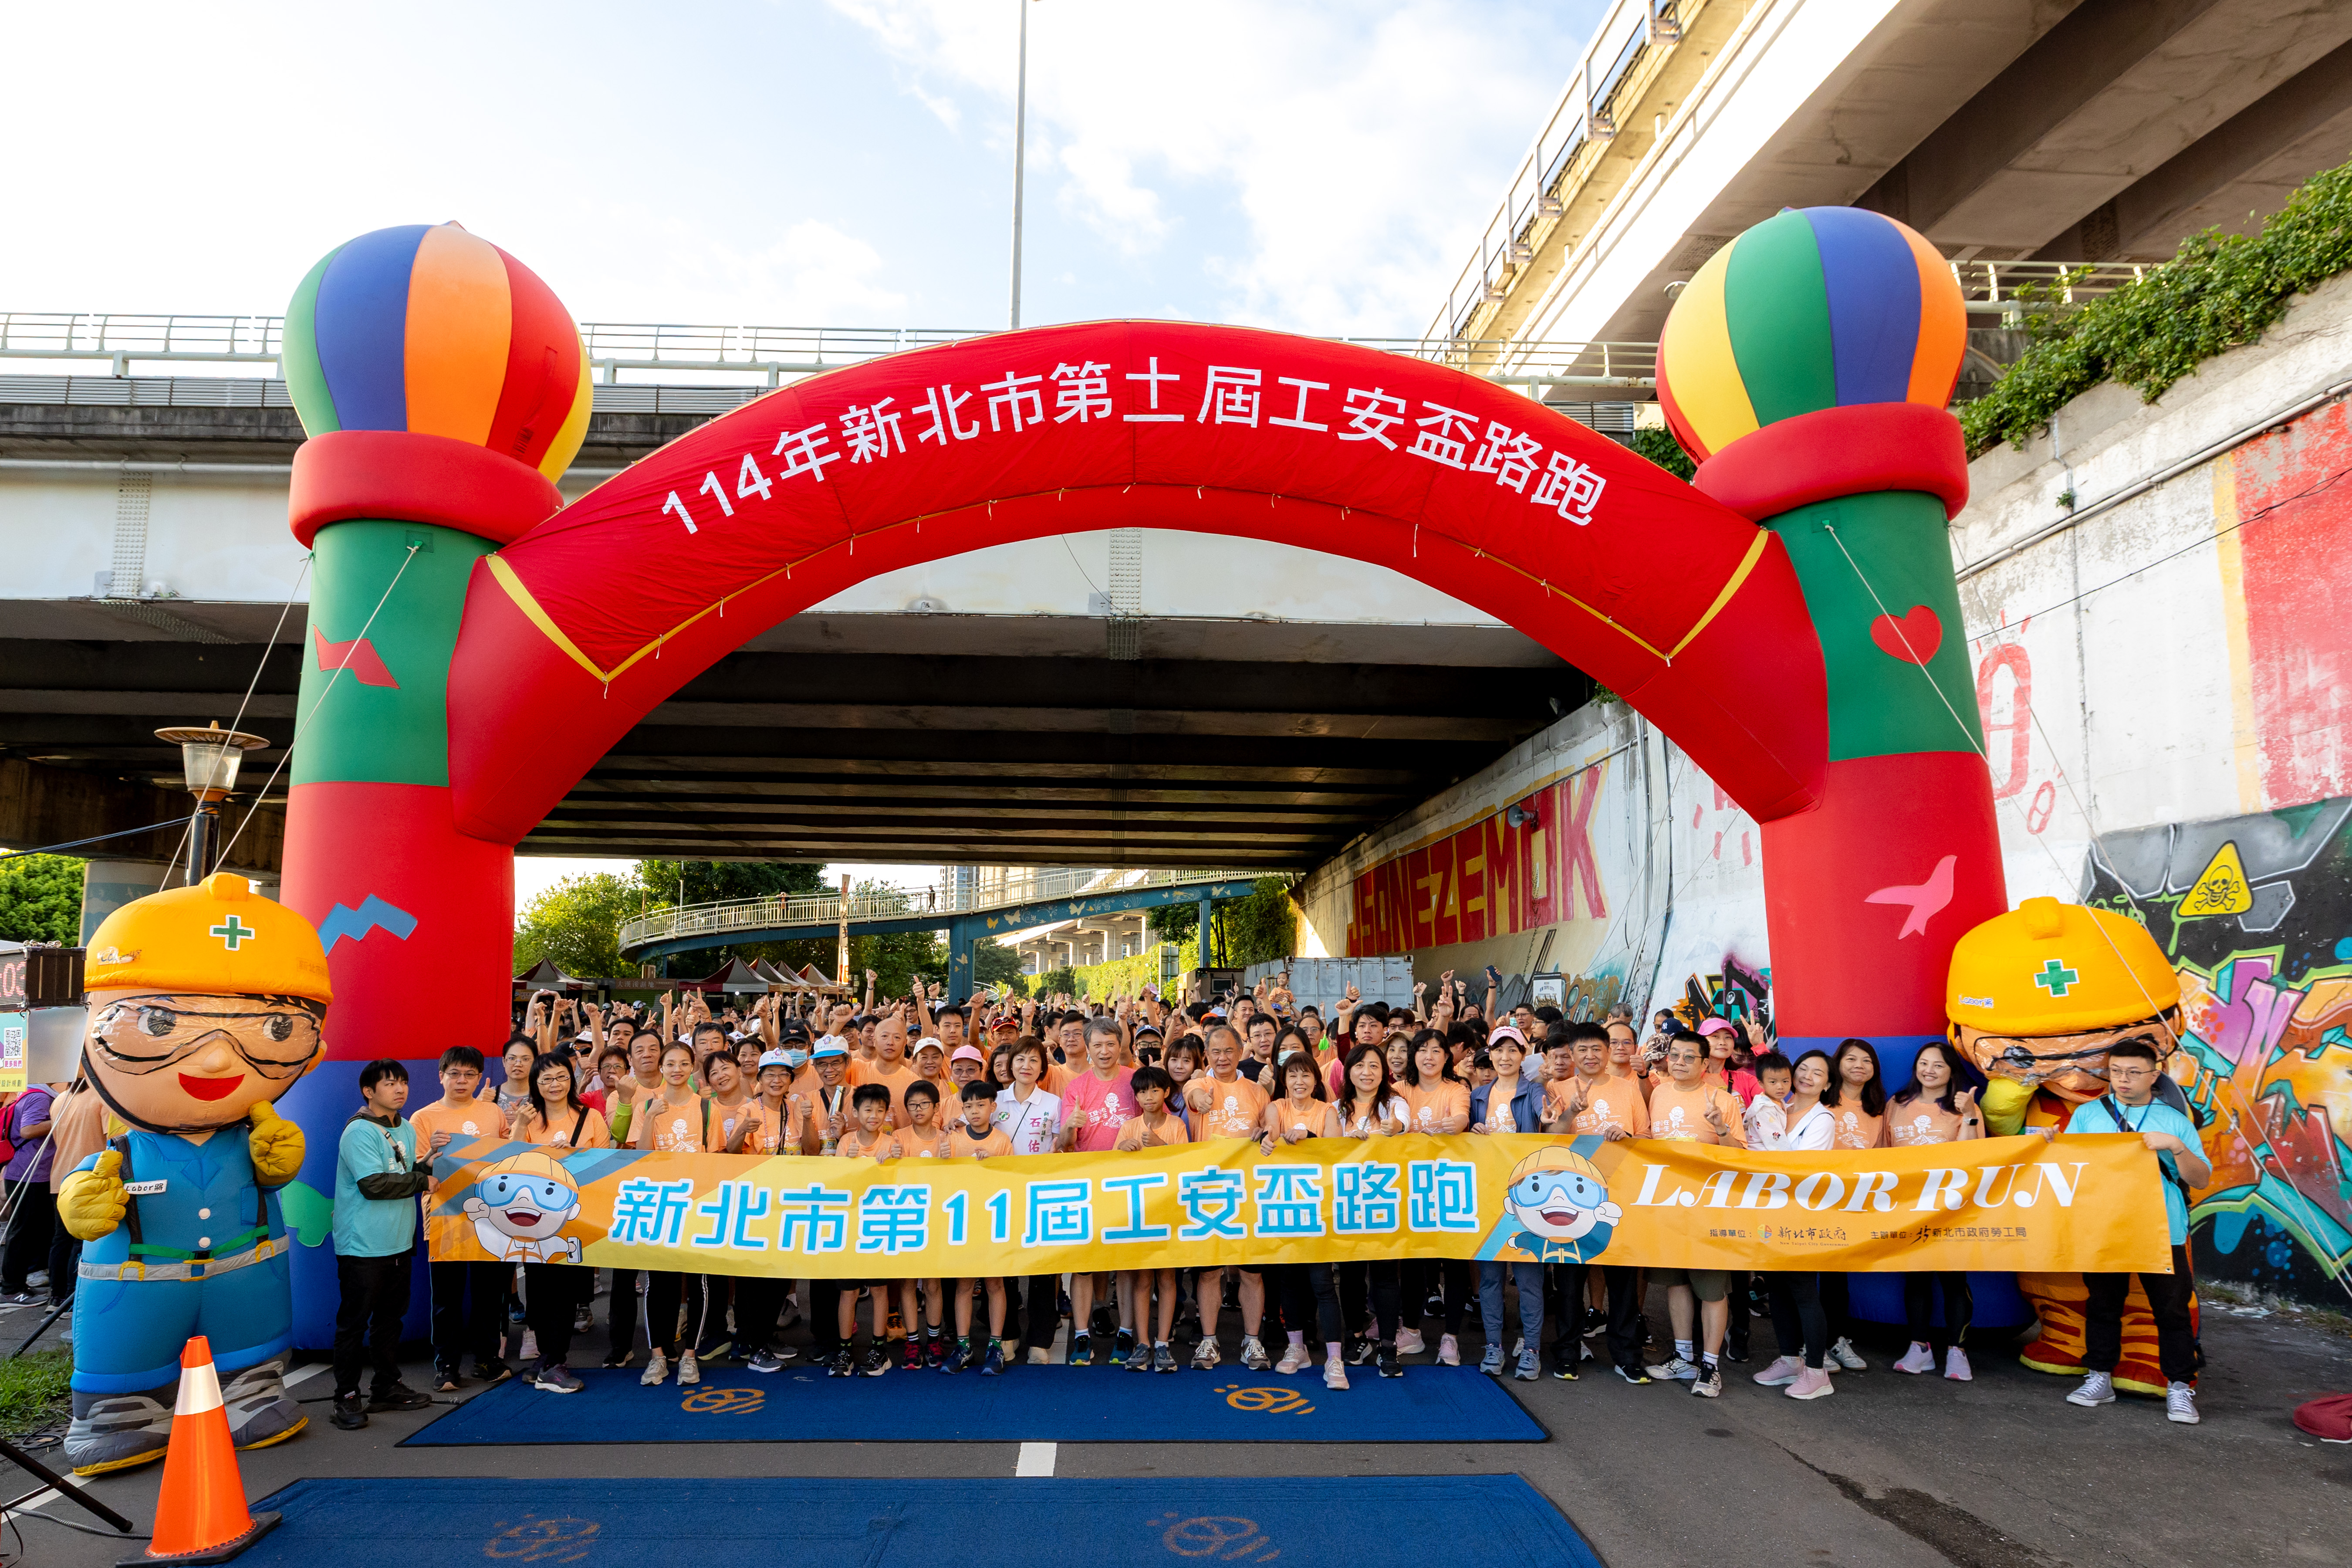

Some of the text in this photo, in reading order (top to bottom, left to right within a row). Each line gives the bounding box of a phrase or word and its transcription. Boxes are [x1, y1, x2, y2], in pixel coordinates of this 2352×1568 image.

[1028, 1118, 1041, 1152] 石一佑
[126, 1183, 164, 1192] Labor將
[1630, 1162, 2089, 1212] LABOR RUN
[611, 1160, 1479, 1254] 新北市第11屆工安盃路跑
[1778, 1227, 1846, 1240] 新北市政府
[1932, 1227, 2027, 1237] 新北市政府勞工局
